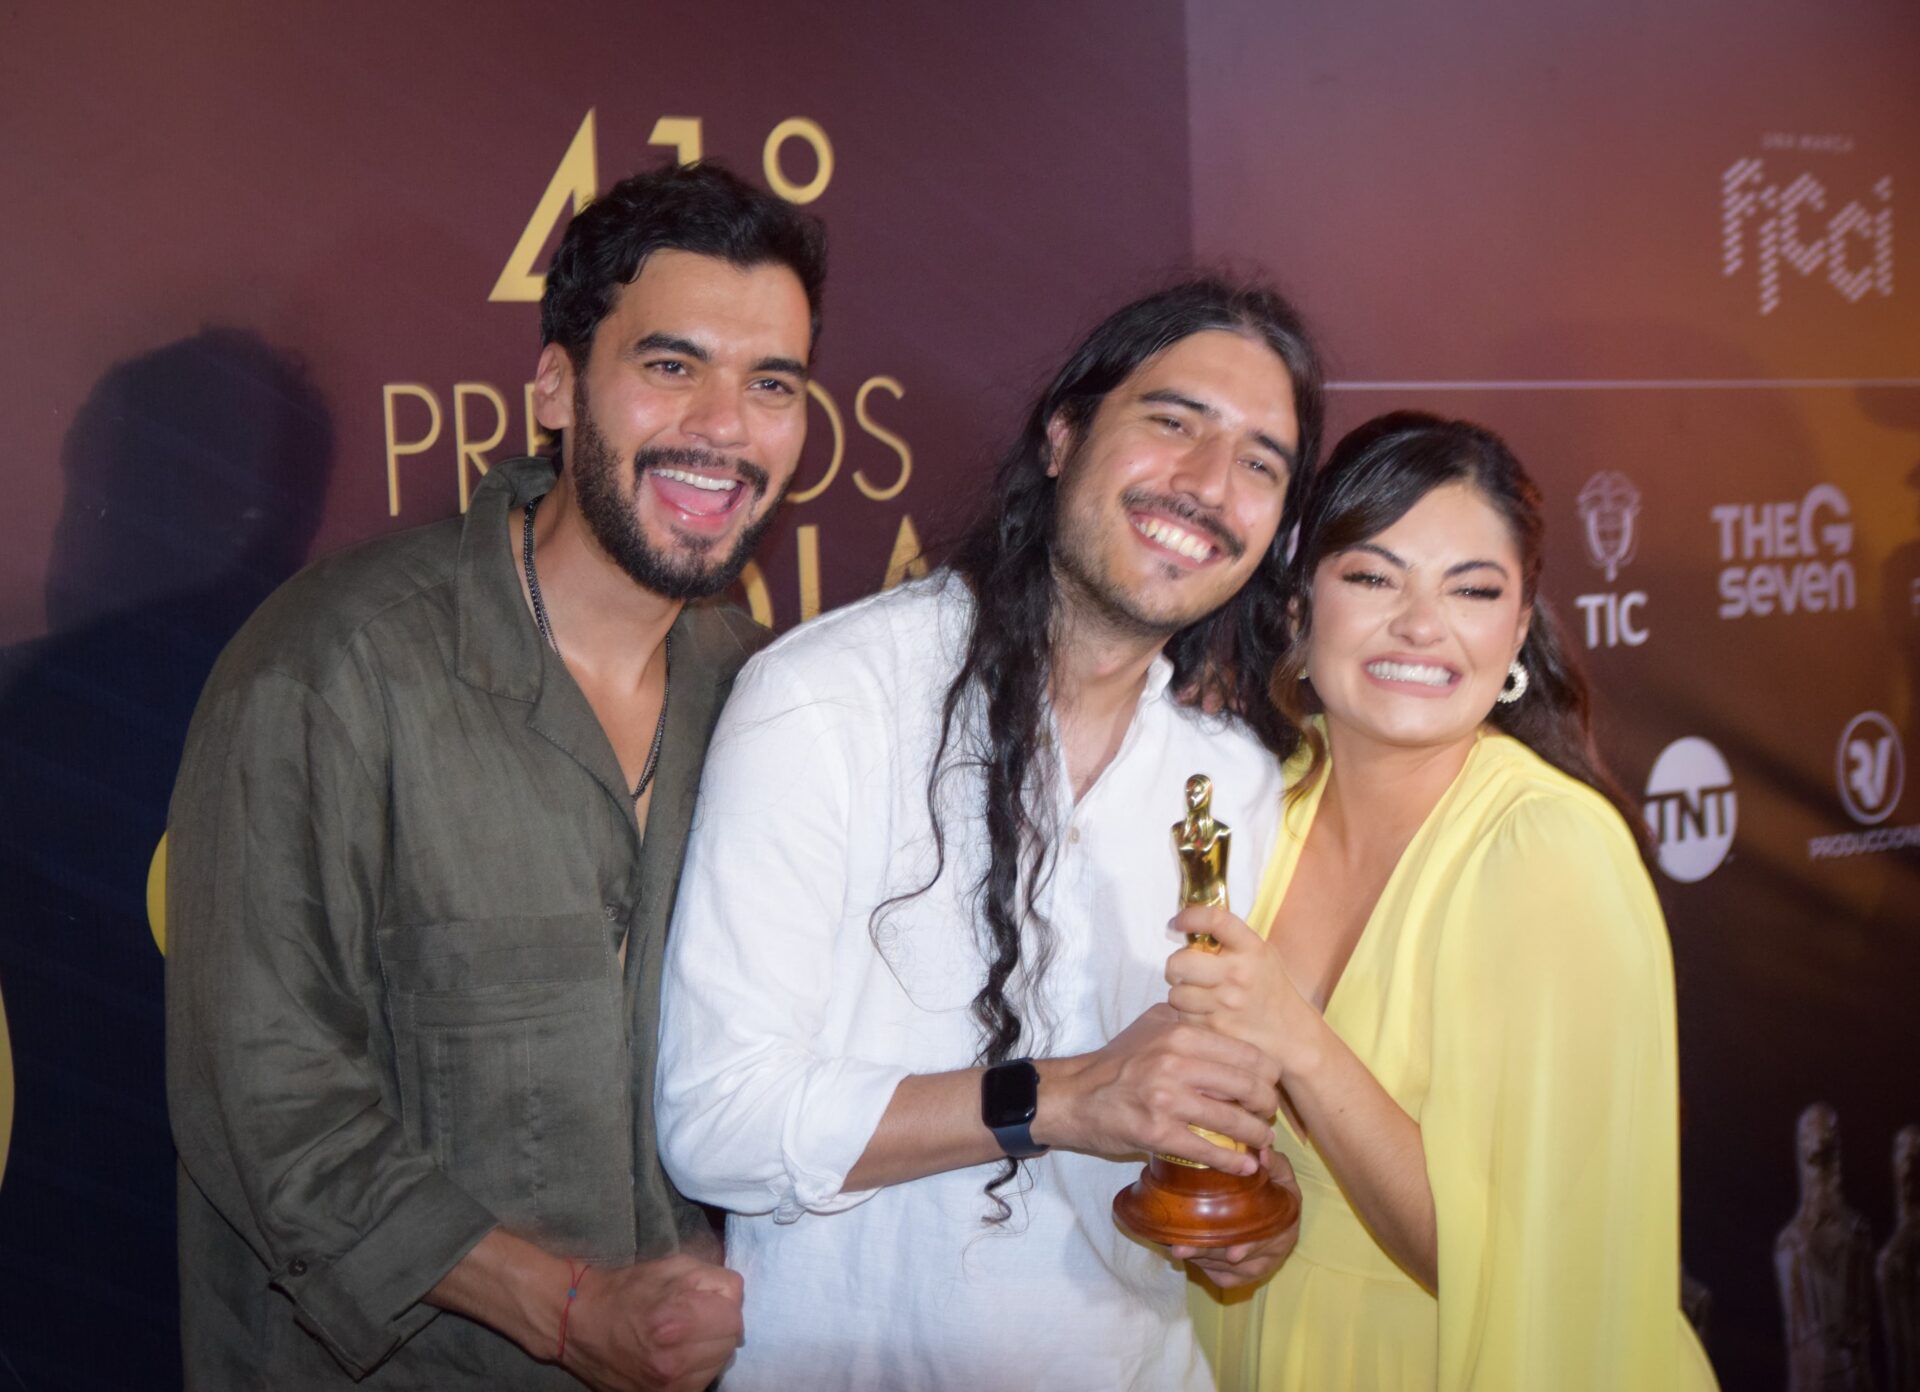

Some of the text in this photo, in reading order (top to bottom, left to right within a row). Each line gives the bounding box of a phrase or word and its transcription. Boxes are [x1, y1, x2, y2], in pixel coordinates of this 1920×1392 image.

[382, 376, 914, 517] PROS
[1575, 591, 1650, 650] TIC
[1641, 785, 1736, 843] TNT
